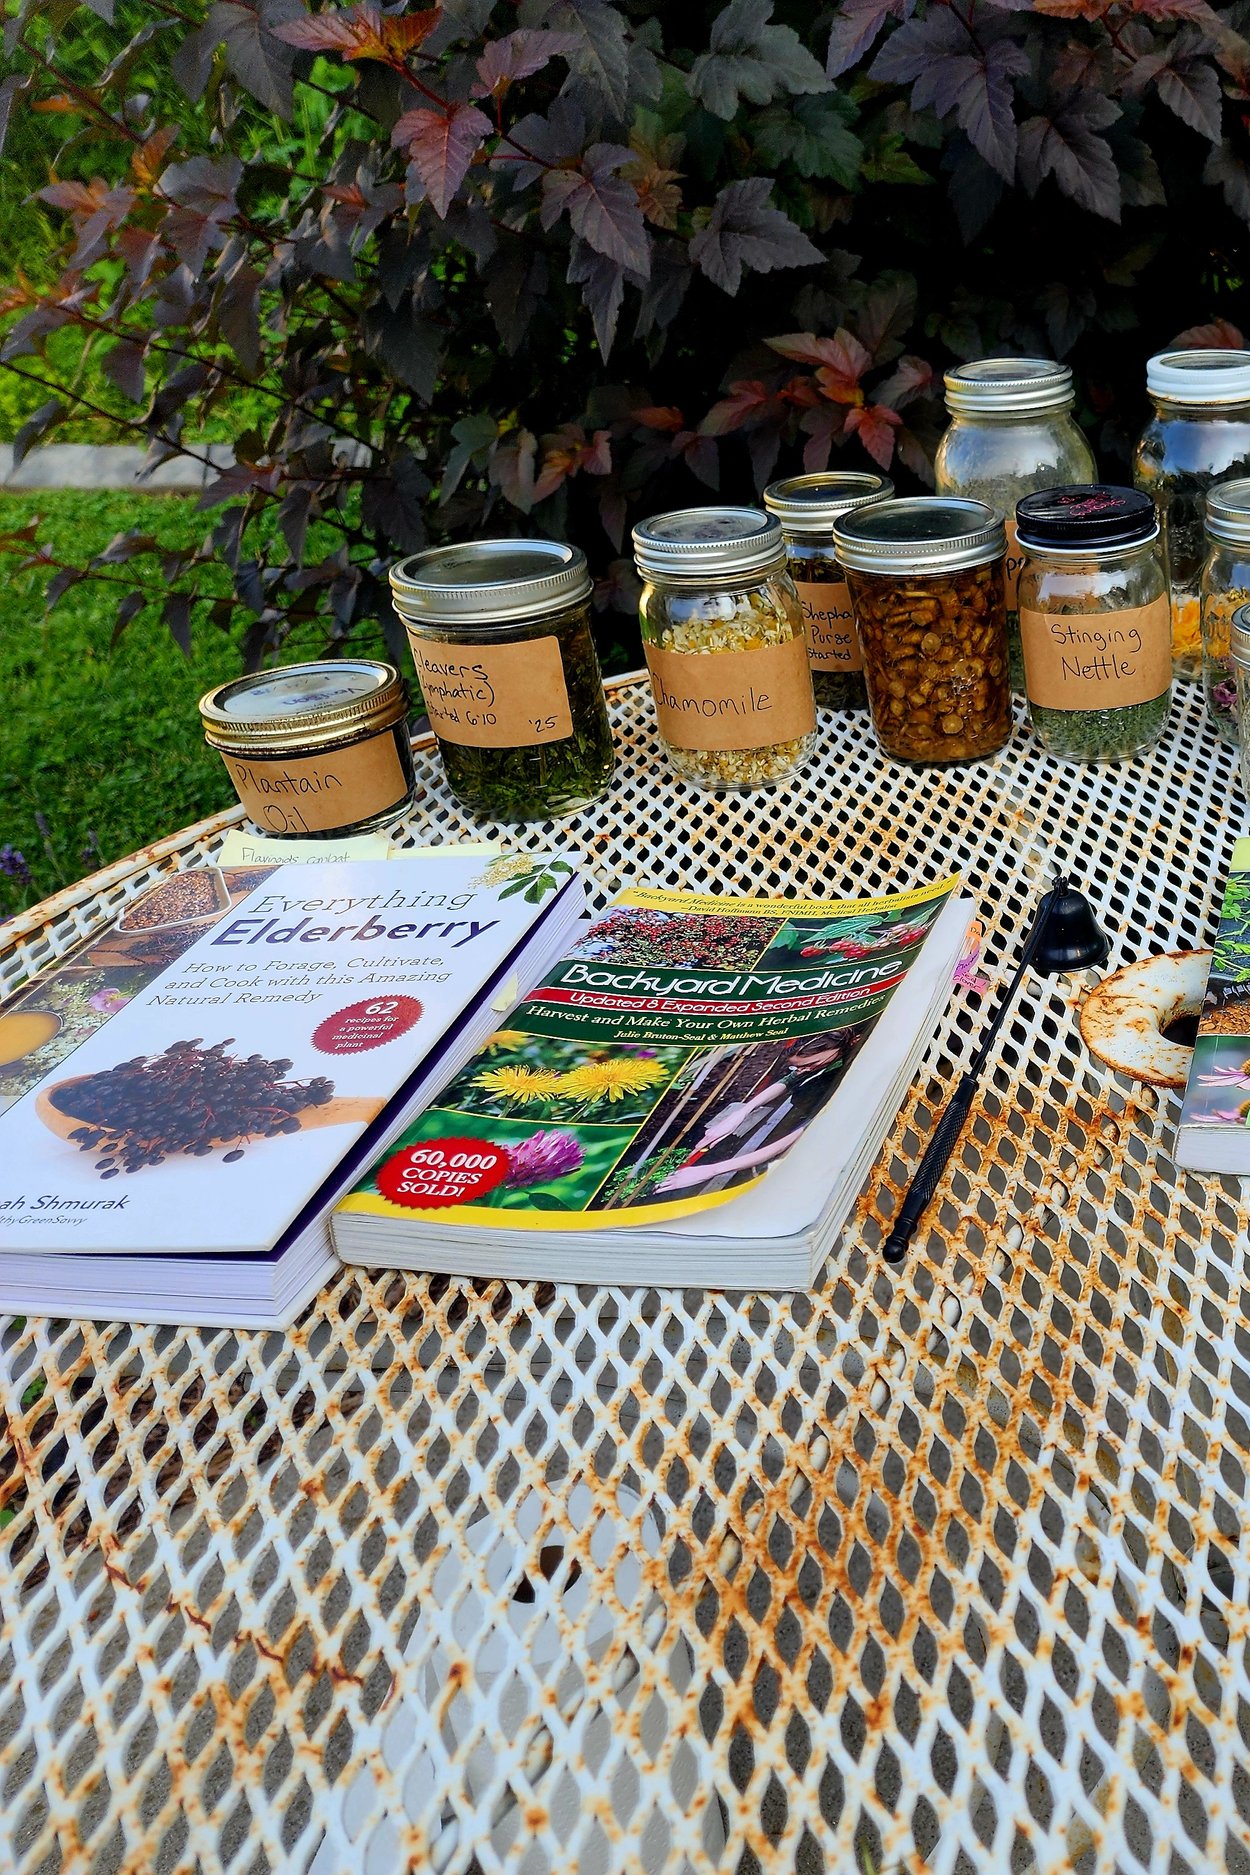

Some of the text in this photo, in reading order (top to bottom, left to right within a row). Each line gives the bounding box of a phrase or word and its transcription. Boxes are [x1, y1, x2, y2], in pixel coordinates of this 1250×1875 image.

[801, 600, 853, 629] Shepha
[811, 624, 853, 645] Purse
[1050, 623, 1143, 654] Stinging
[807, 647, 852, 661] Started
[413, 647, 489, 681] Cleavers
[1061, 656, 1137, 681] Nettle
[651, 672, 774, 718] Chamomile
[528, 714, 559, 733] '25
[235, 763, 343, 796] Plantain
[262, 804, 311, 833] Oil
[248, 889, 478, 915] Everything
[210, 914, 501, 948] Elderberry
[181, 955, 445, 973] How to Forage, Cultivate,
[164, 970, 453, 989] and Cook with this Amazing
[560, 959, 903, 997] Backyard Medicine
[145, 989, 324, 1006] Natural Remedy
[569, 987, 871, 1013] Updated & Expanded Second Edition
[365, 1001, 399, 1015] 62
[526, 994, 886, 1030] Harvest and Make Your Own Herbal Remedies
[345, 1016, 381, 1024] recipes
[346, 1023, 394, 1033] powerful
[332, 1032, 384, 1040] medicinal
[614, 1030, 641, 1039] Julie
[642, 1031, 706, 1041] Bruton-Seal
[719, 1031, 764, 1041] Matthew
[764, 1027, 790, 1037] Seal
[334, 1041, 364, 1049] plant
[410, 1149, 498, 1169] 60,000
[402, 1167, 483, 1184] COPIES
[396, 1181, 466, 1197] SOLD!
[0, 1194, 131, 1210] ah Shmurak
